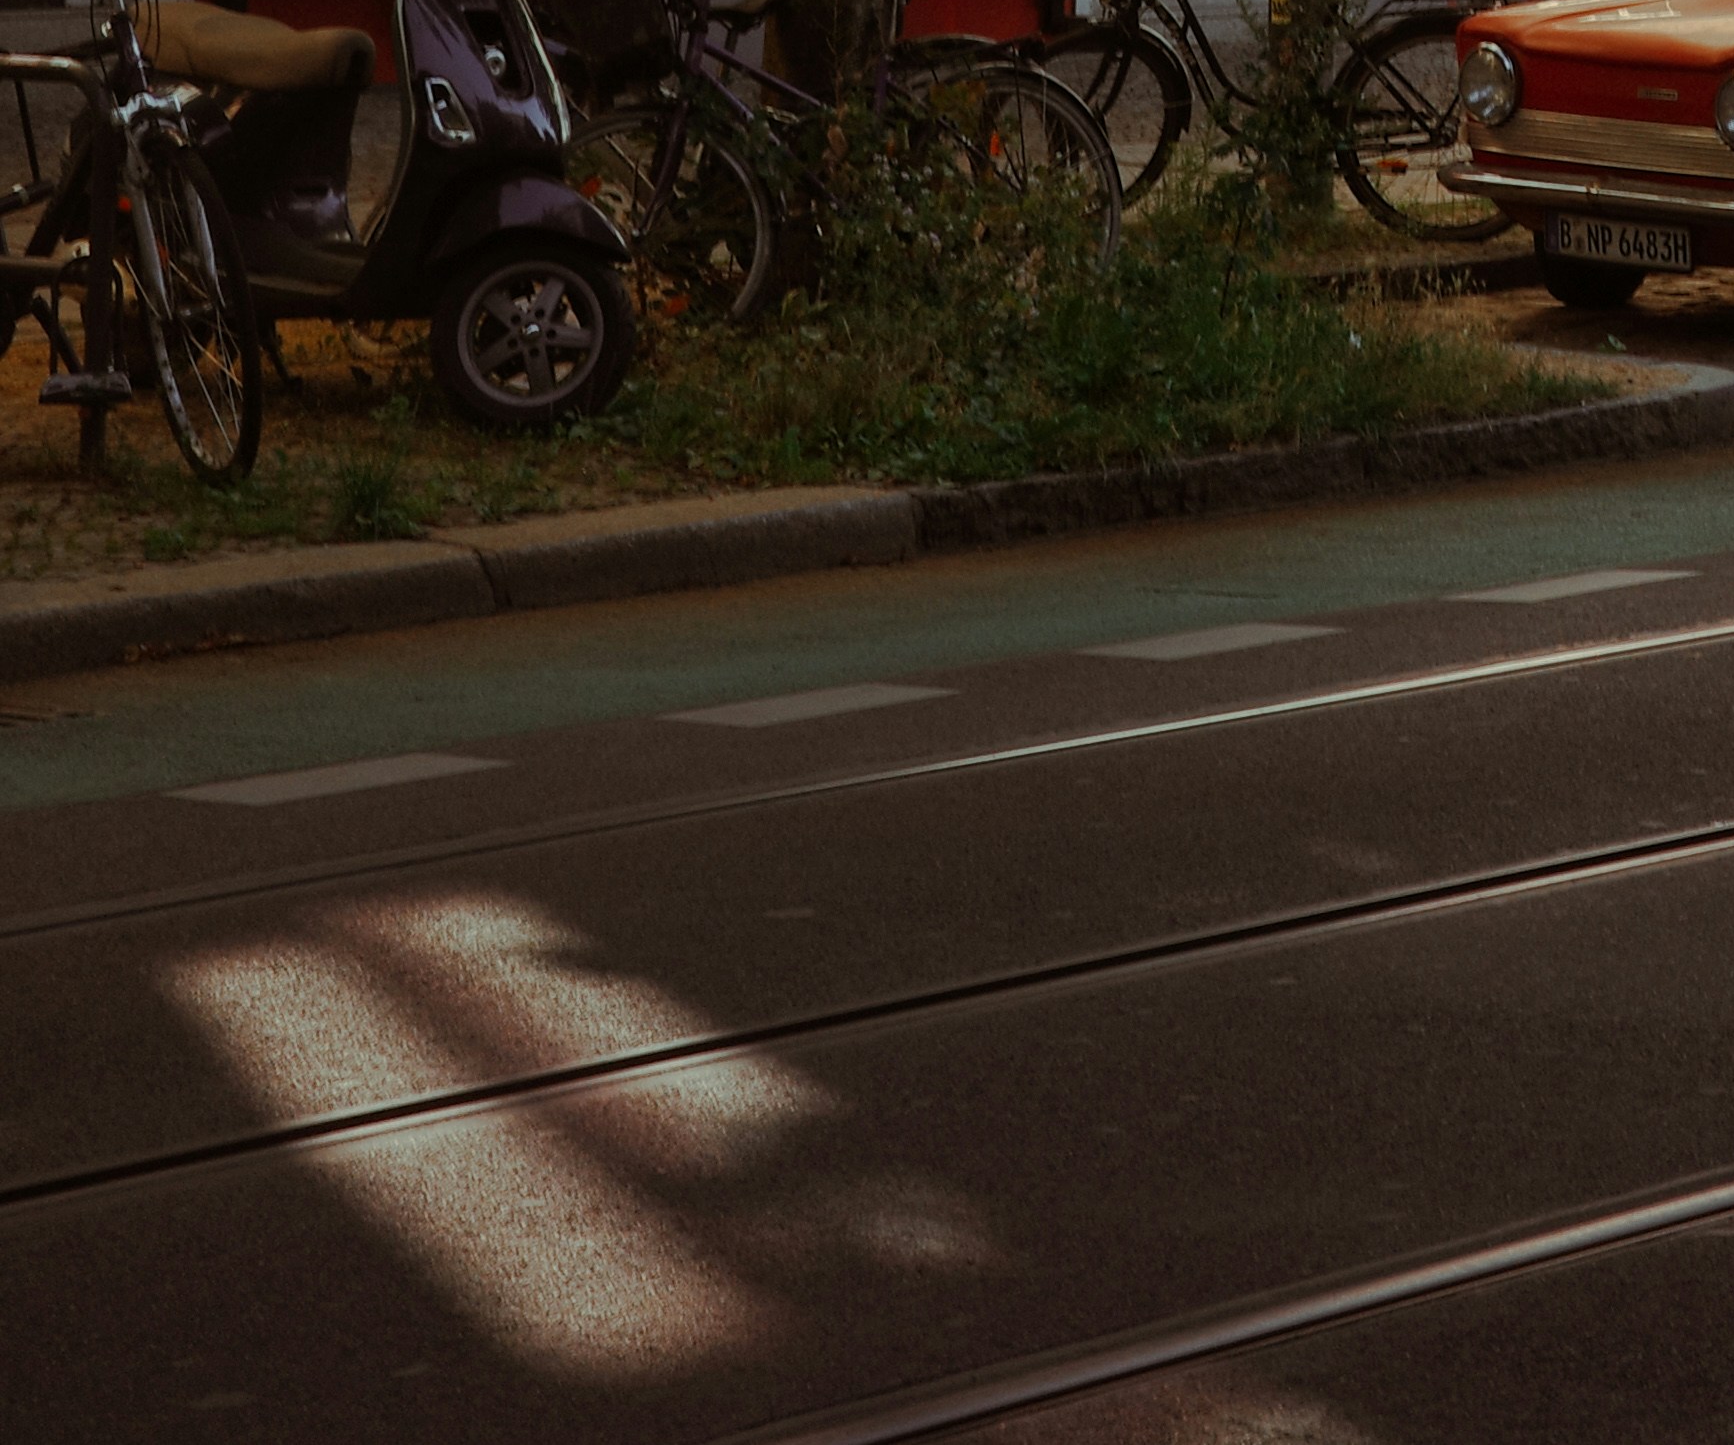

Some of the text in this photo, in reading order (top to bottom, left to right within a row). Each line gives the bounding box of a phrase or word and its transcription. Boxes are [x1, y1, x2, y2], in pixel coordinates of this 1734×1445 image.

[1560, 219, 1688, 264] B NP 6483H
